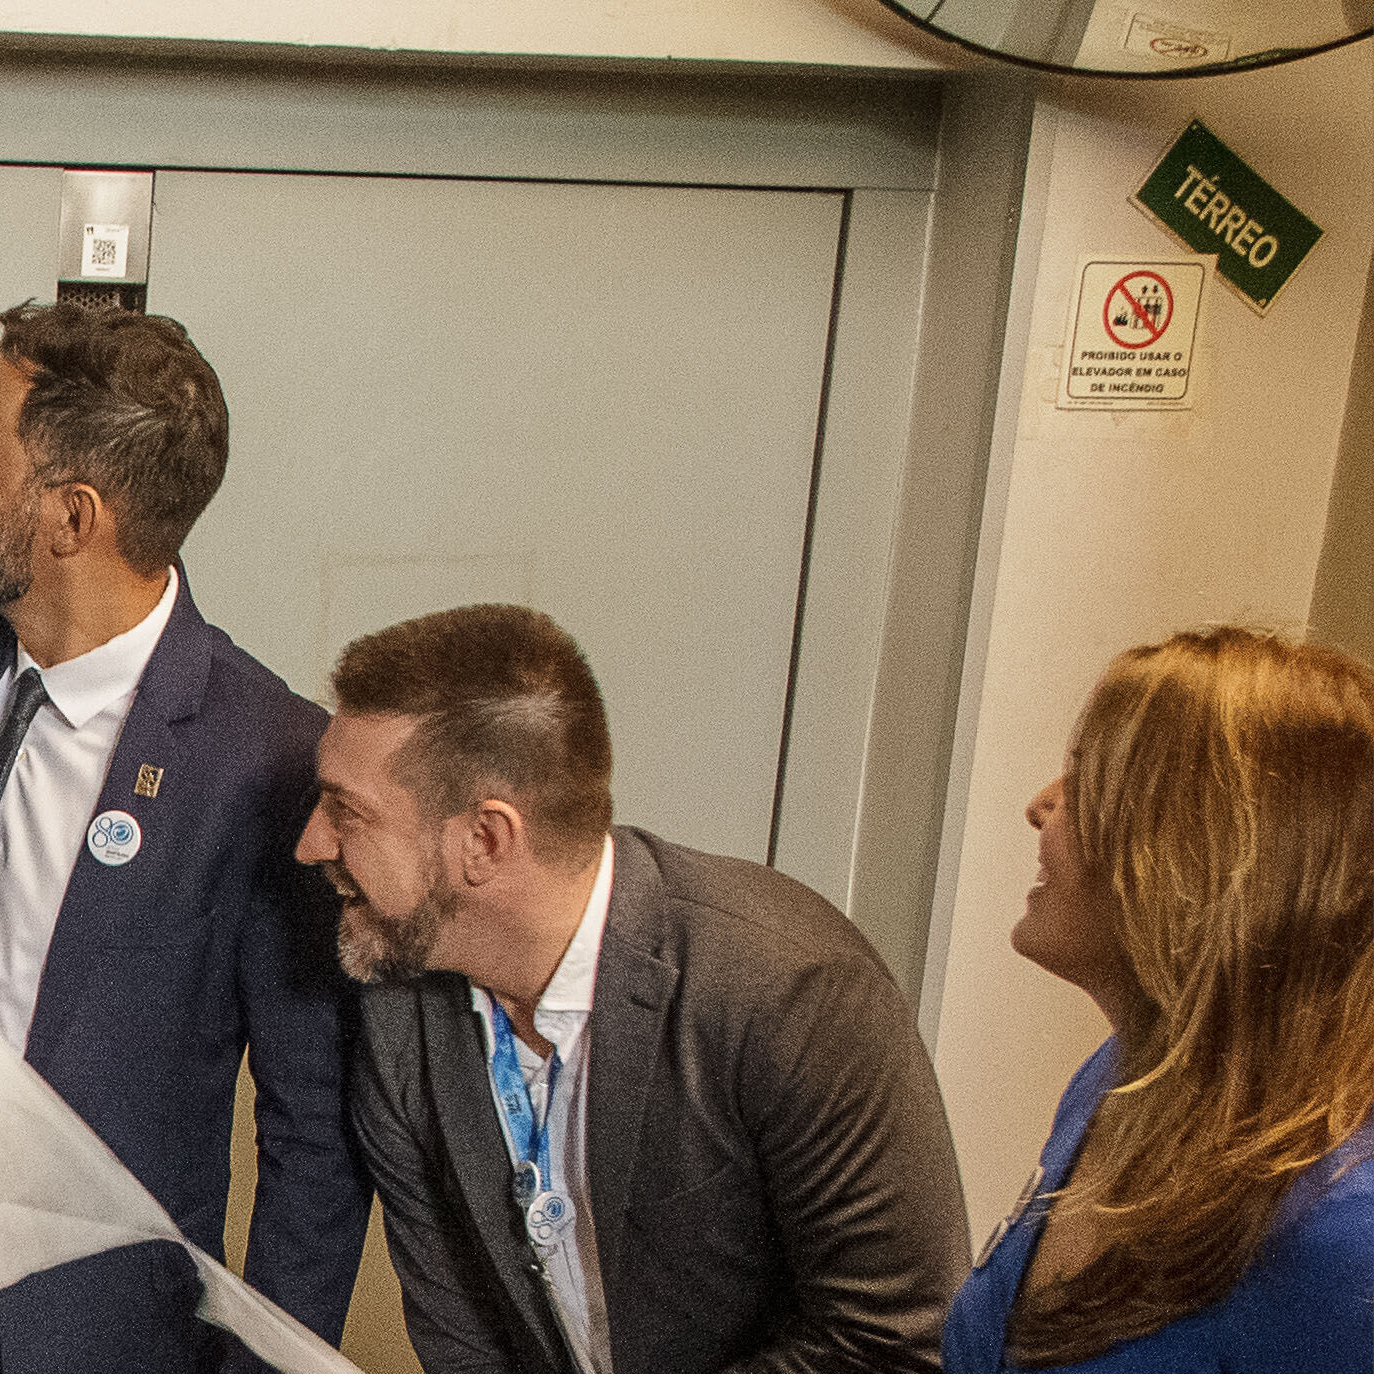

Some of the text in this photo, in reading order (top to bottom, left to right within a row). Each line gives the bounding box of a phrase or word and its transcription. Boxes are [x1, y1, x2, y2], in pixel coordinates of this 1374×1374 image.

[1174, 164, 1278, 268] TÉRREO
[1080, 351, 1183, 361] PROIBIDO USAR O
[1072, 366, 1187, 377] ELEVADOR EM CASO
[1090, 380, 1164, 393] DE INCÊNDIO
